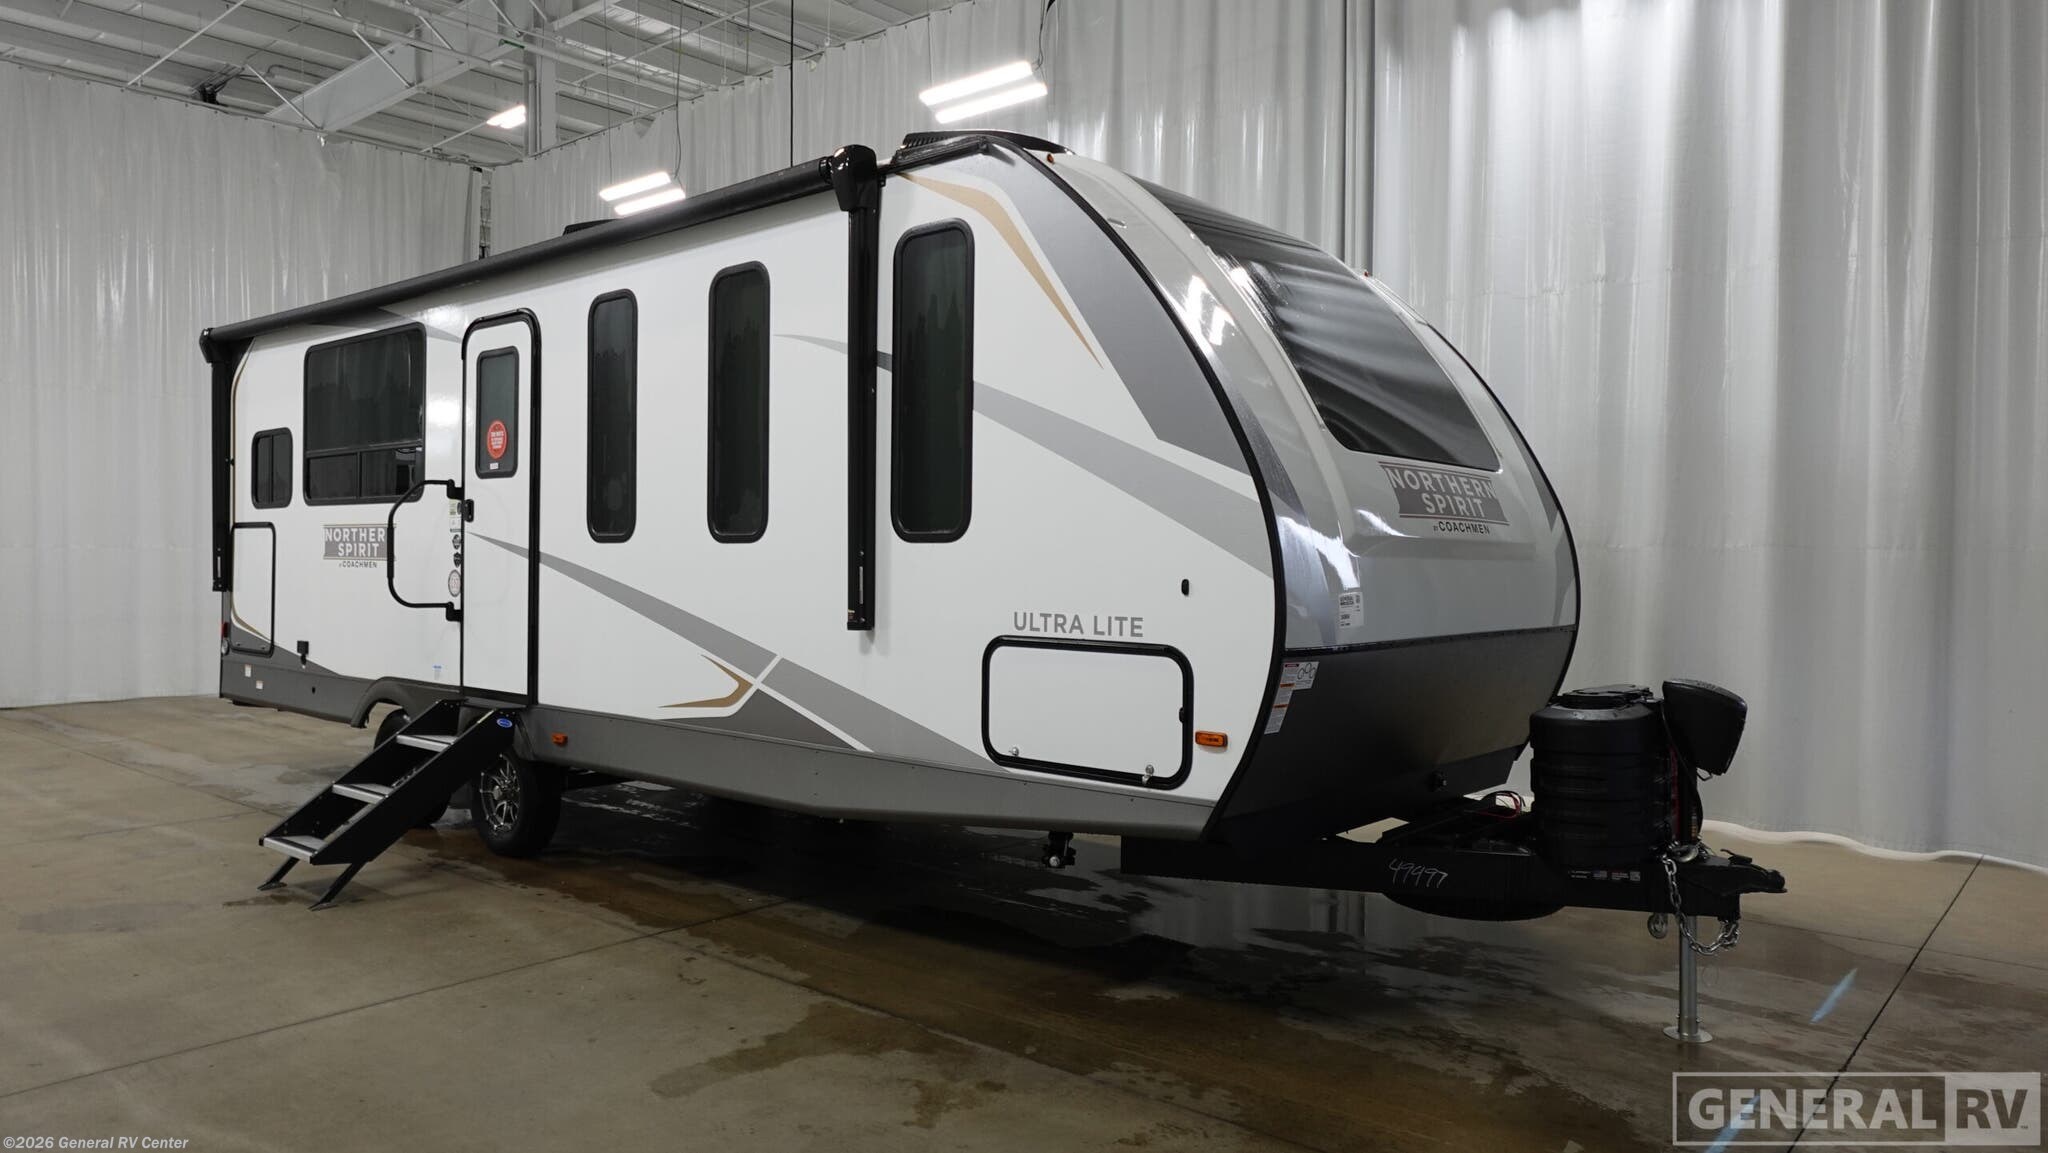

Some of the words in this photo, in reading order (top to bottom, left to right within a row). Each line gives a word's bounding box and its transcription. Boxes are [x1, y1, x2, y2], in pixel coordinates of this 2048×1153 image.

[1386, 467, 1497, 499] NORTHERN
[1422, 493, 1485, 518] SPIRIT
[325, 528, 385, 541] NORTHER
[1438, 521, 1490, 534] COACHMEN
[338, 543, 379, 557] SPIRIT
[1014, 611, 1084, 634] ULTRA
[1093, 615, 1143, 637] LITE
